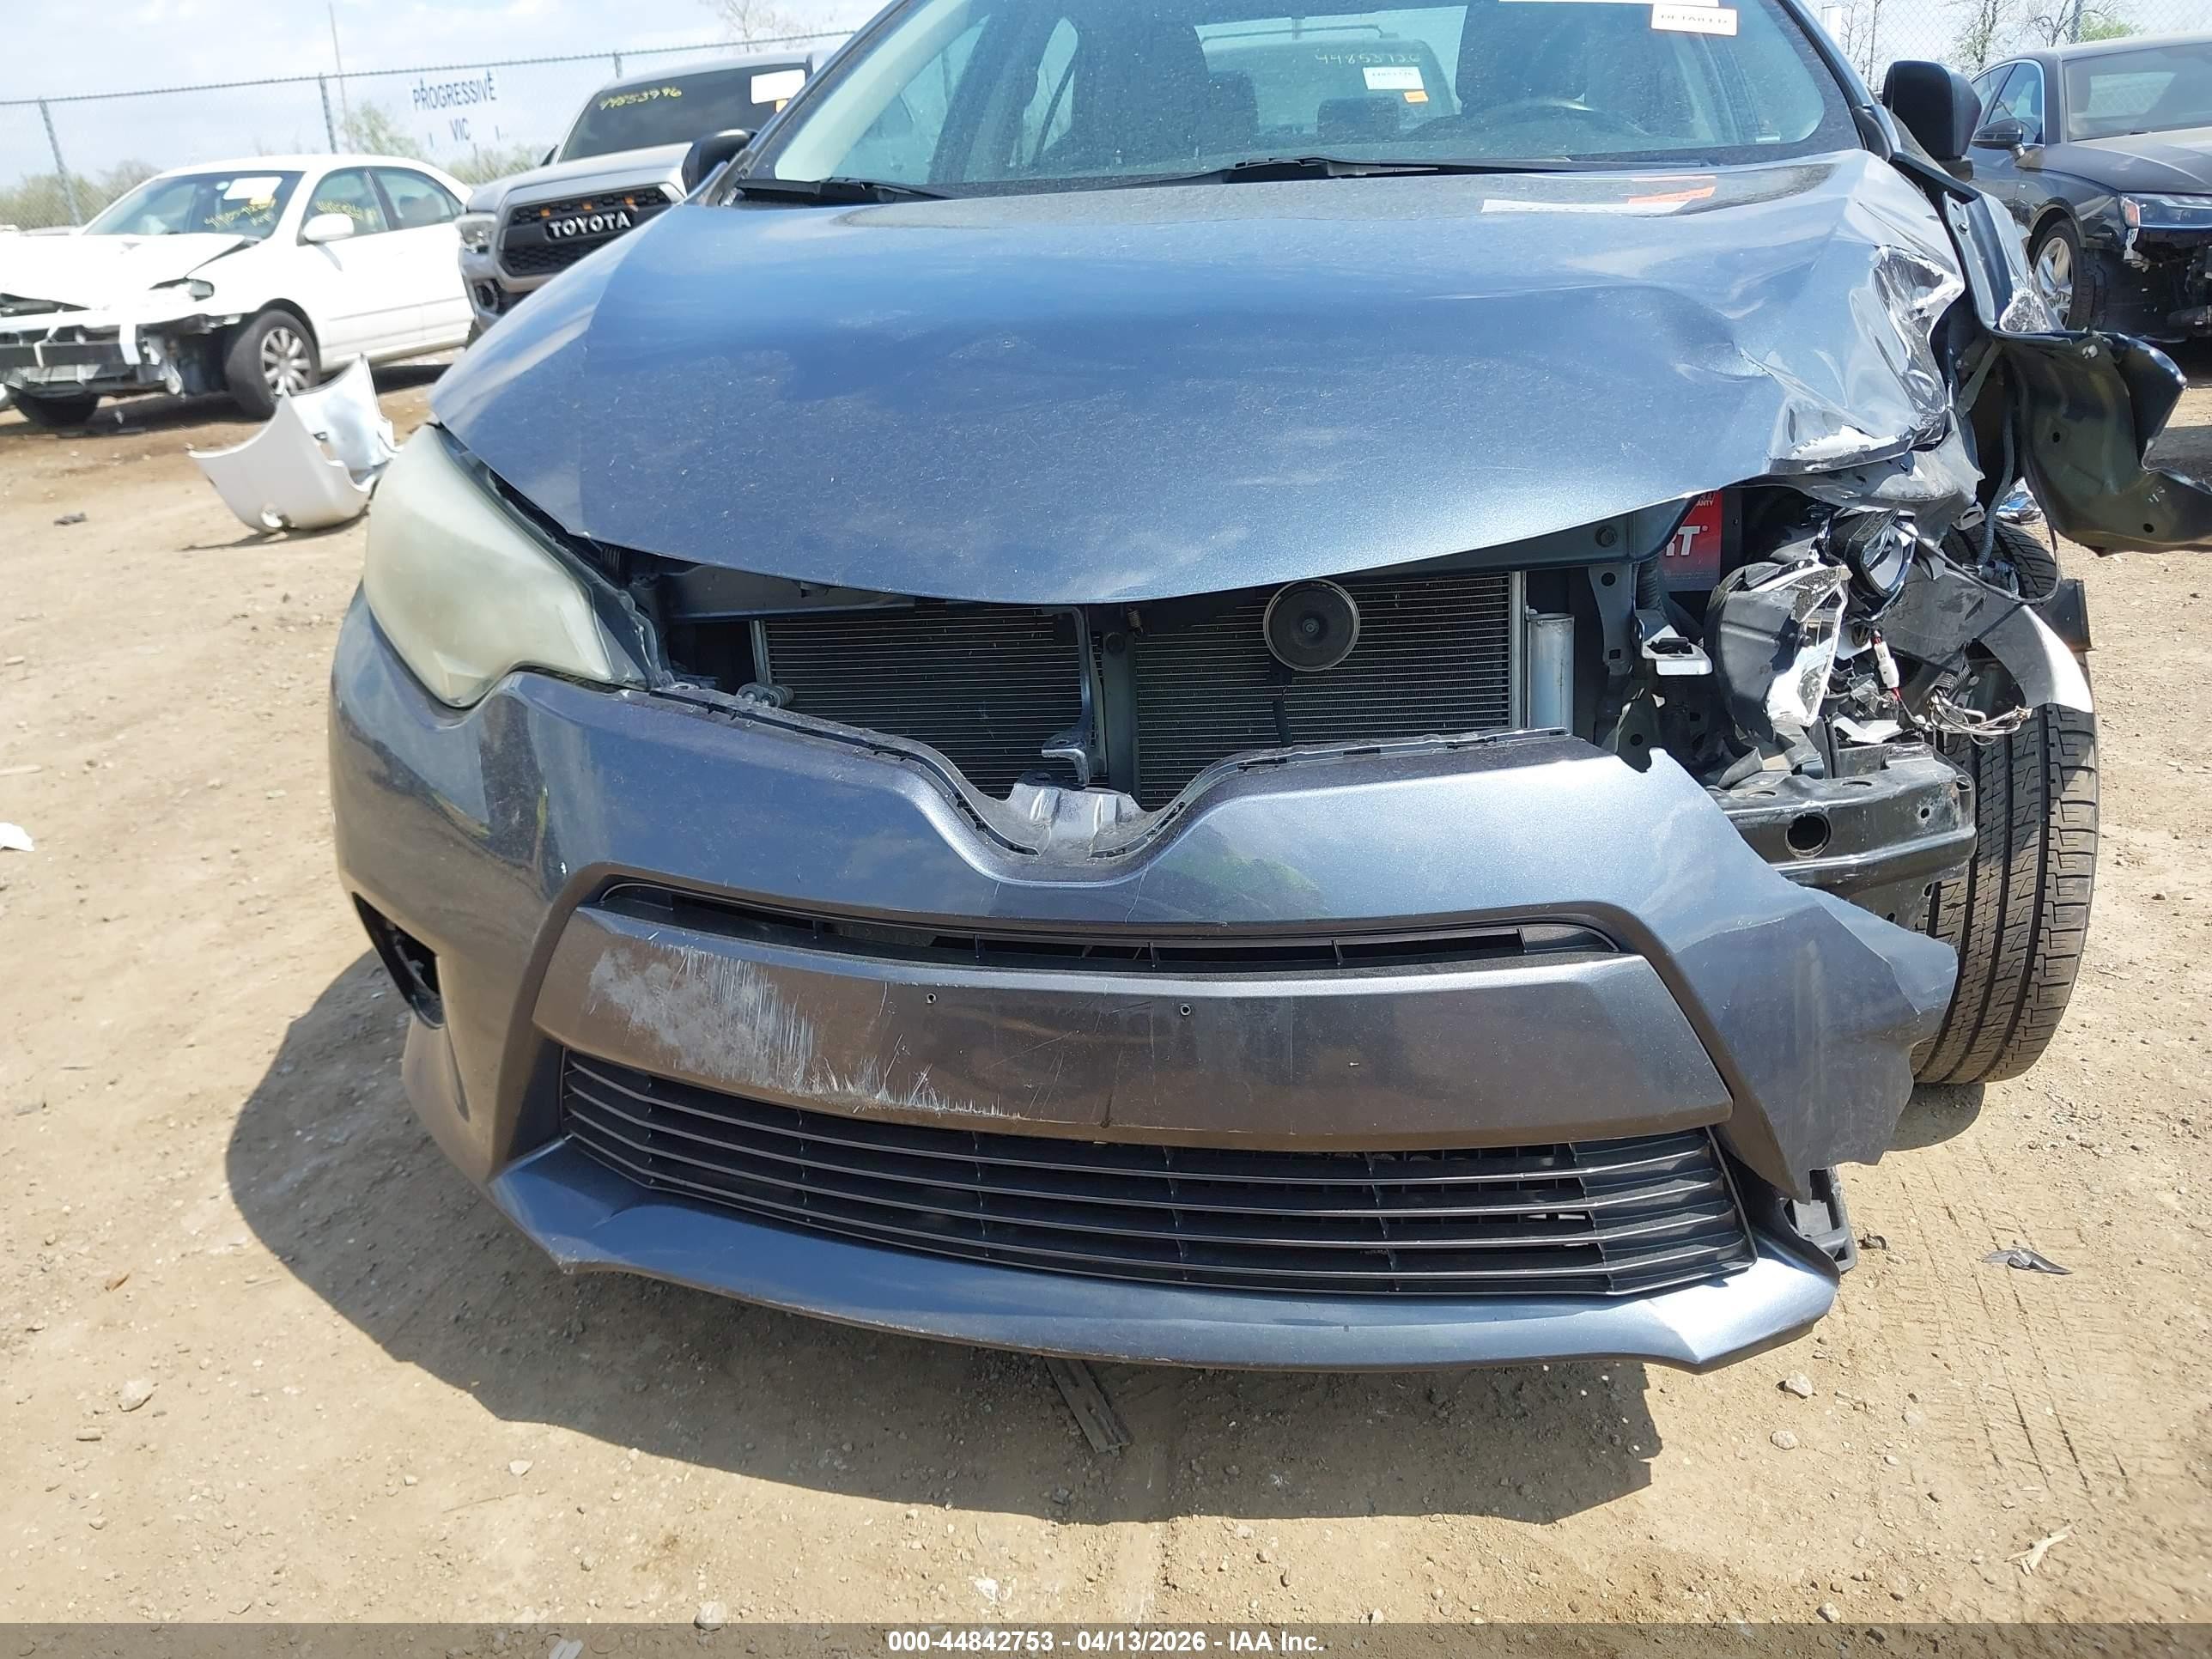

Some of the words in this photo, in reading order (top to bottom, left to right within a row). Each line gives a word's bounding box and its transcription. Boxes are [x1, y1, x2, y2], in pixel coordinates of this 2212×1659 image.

[412, 74, 497, 110] PROGRESSIVE
[448, 118, 471, 141] VIC
[549, 210, 632, 238] TOYOTA
